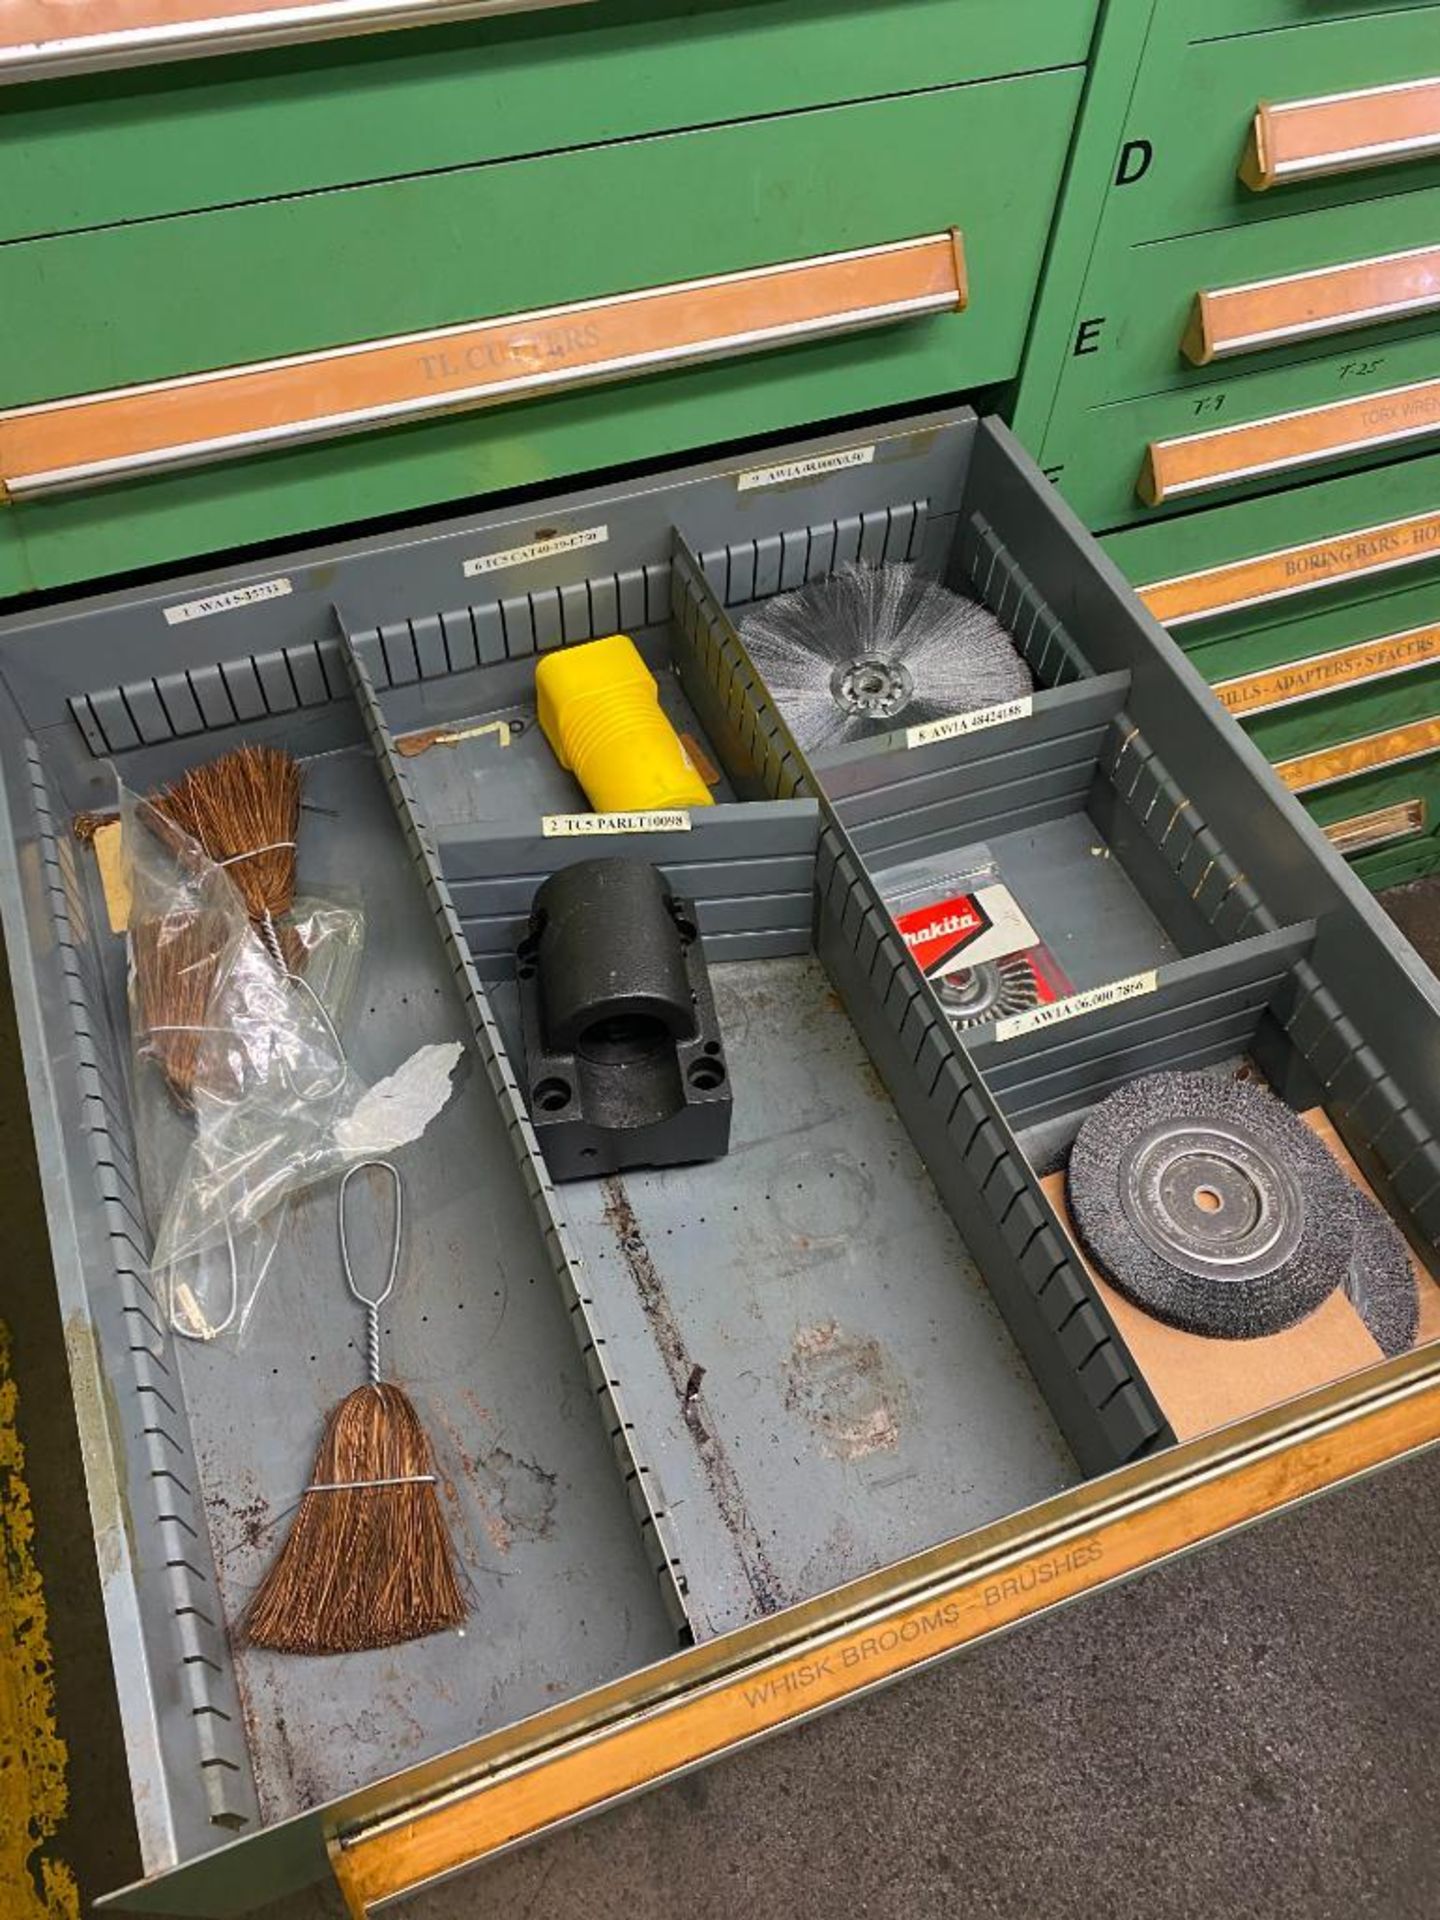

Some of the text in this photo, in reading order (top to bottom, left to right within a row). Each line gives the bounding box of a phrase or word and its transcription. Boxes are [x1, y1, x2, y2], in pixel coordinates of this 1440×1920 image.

[1114, 139, 1153, 186] D
[1073, 317, 1106, 357] E
[1285, 549, 1351, 576] BORING
[1356, 535, 1399, 558] BARS
[1412, 524, 1440, 545] HO
[1217, 684, 1261, 707] RILLS
[1271, 660, 1353, 693] ADAPTERS
[551, 820, 558, 831] 2
[739, 1658, 836, 1709] WHISK
[841, 1604, 960, 1669] BROOMS
[983, 1540, 1104, 1608] BRUSHES
